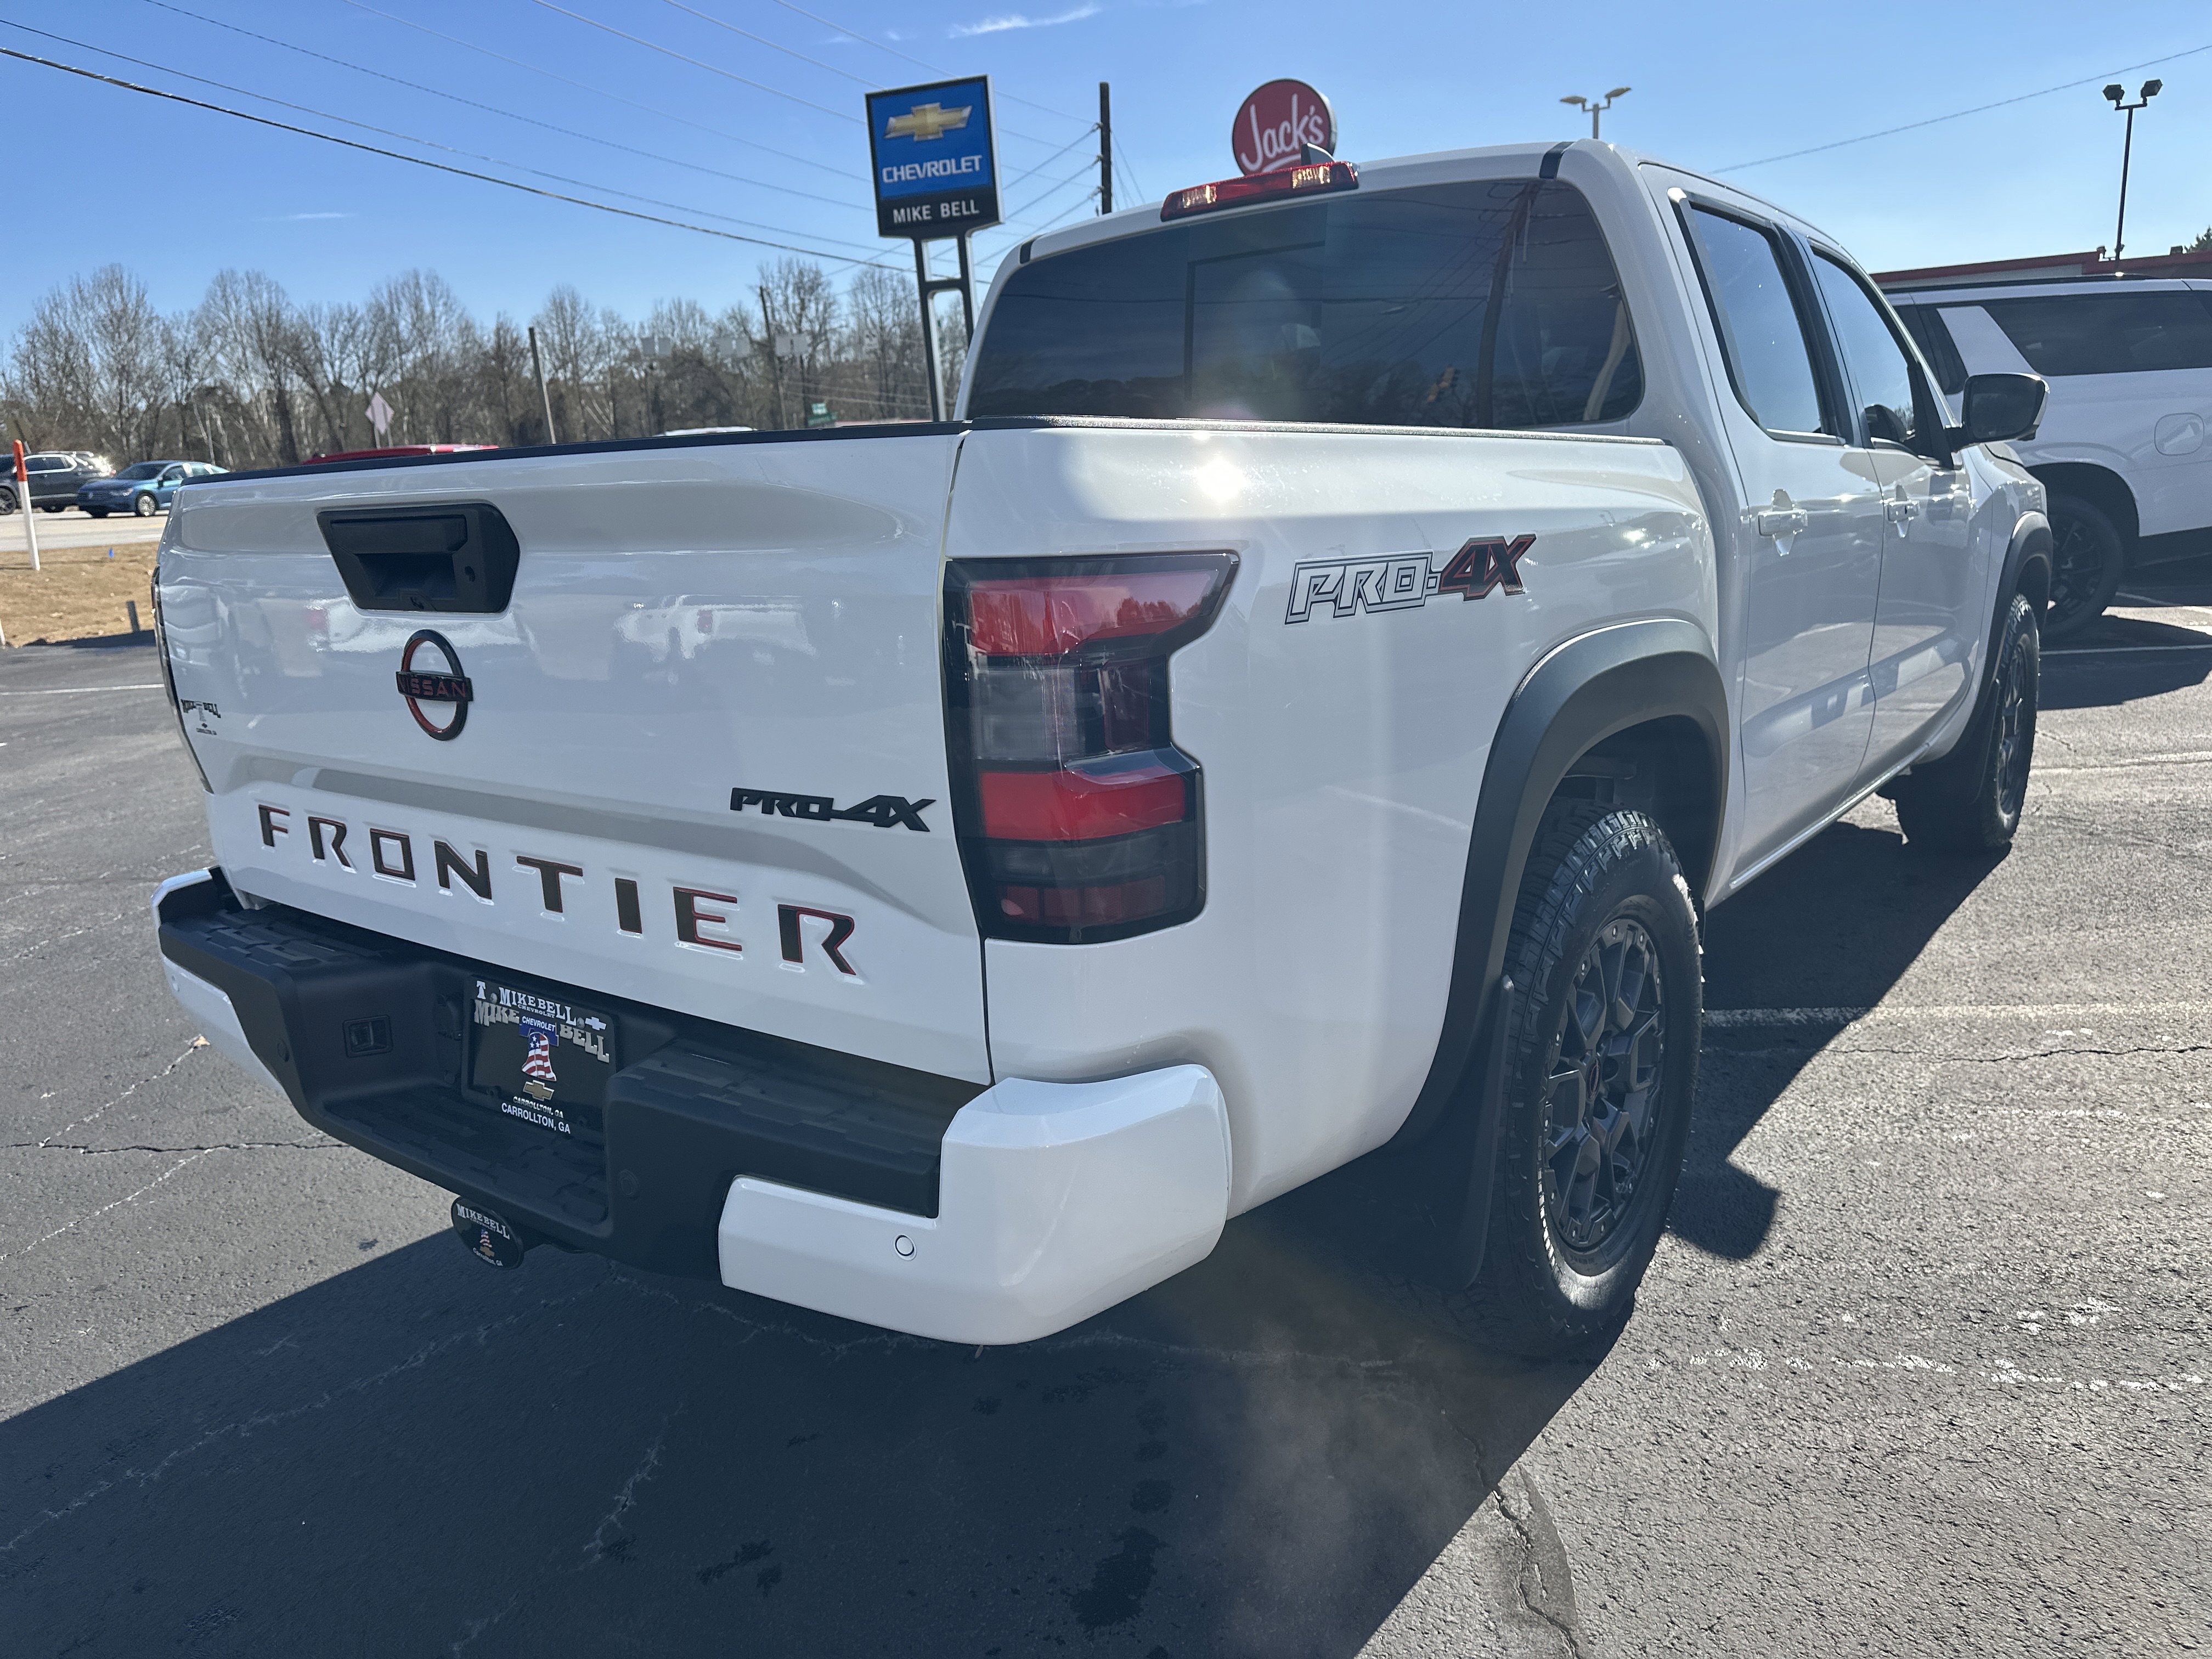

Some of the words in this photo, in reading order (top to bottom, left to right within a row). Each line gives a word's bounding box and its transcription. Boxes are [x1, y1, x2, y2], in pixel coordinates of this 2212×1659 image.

[1240, 93, 1325, 172] Jack's
[882, 154, 983, 184] CHEVROLET
[893, 204, 933, 224] MIKE
[940, 199, 980, 218] BELL
[397, 674, 467, 698] NISSAN
[730, 787, 937, 832] PRO-4X
[258, 804, 857, 975] FRONTIER
[499, 986, 536, 1007] MIKE
[537, 997, 577, 1026] BELL
[517, 1003, 556, 1019] CHEVROLET
[473, 999, 520, 1027] MIKE
[560, 1023, 610, 1063] BELL
[522, 1015, 556, 1032] CHEVROLET
[501, 1102, 557, 1131] CARROLLTON,
[558, 1121, 571, 1135] GA
[554, 1109, 564, 1119] GA
[456, 1203, 483, 1222] MIKE
[483, 1215, 510, 1240] BELL
